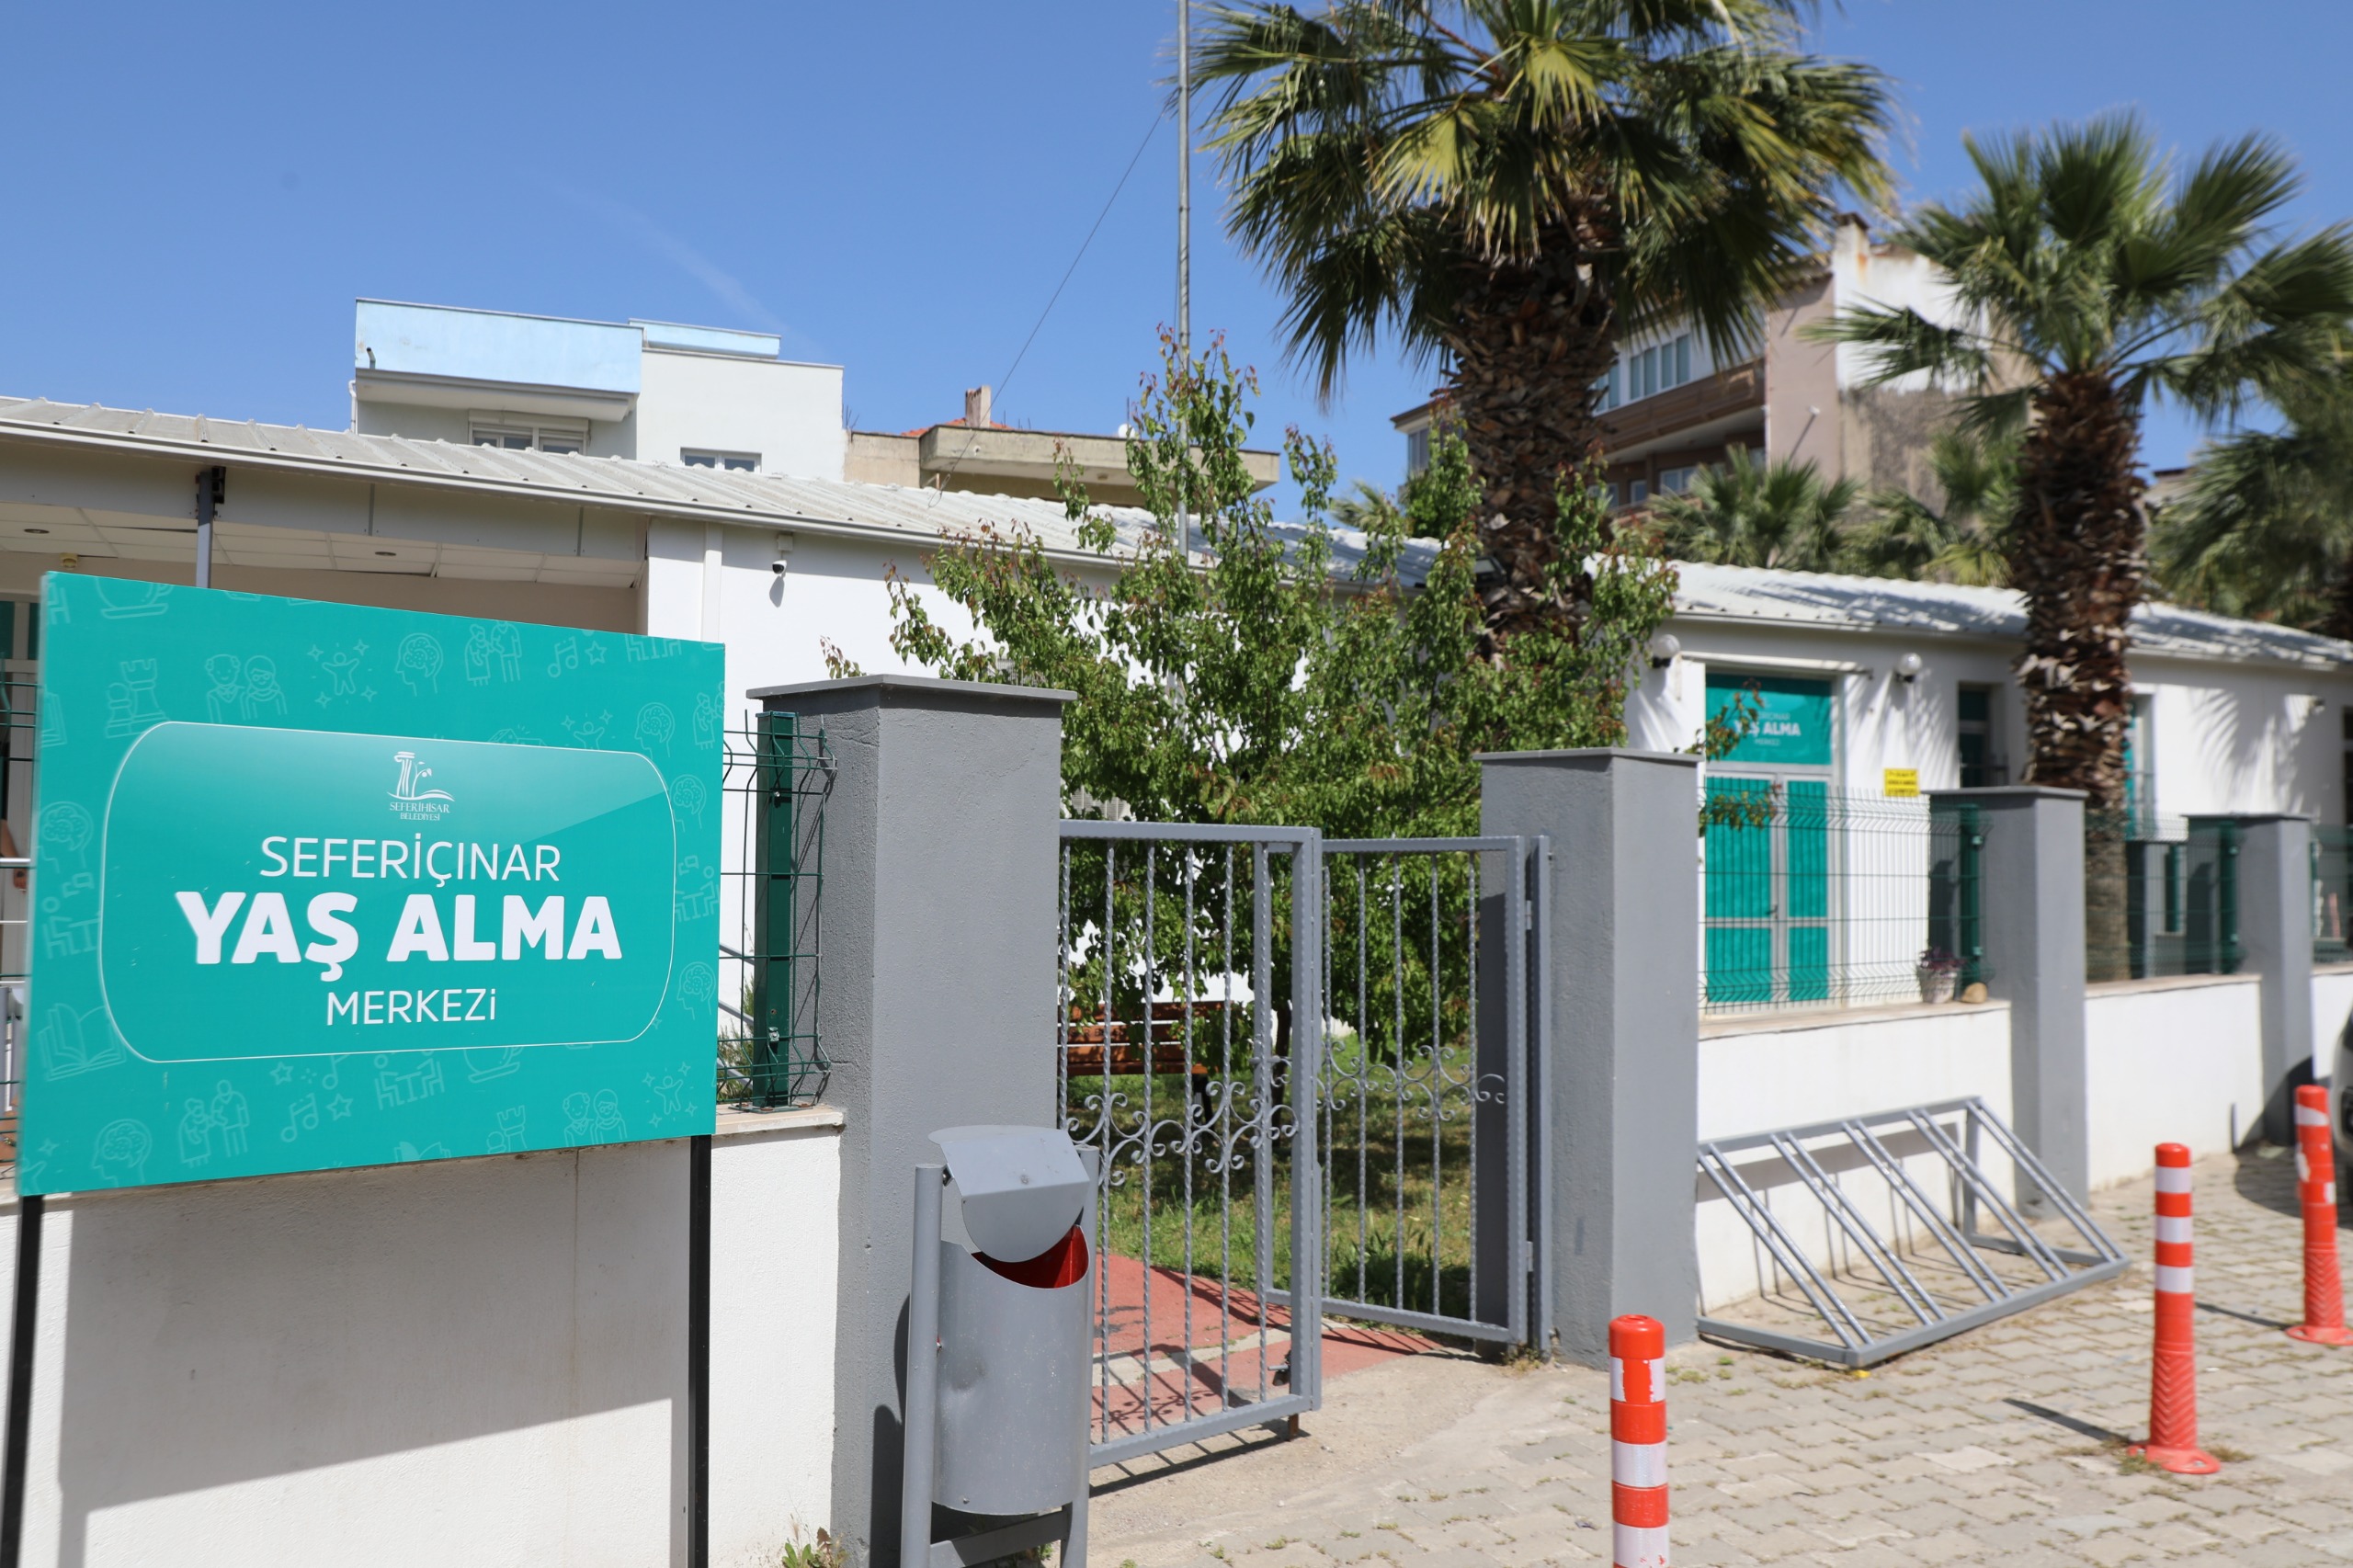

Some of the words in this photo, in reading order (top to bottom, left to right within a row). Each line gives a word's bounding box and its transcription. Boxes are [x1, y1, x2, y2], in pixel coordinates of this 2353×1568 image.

[1763, 721, 1802, 736] ALMA
[390, 801, 450, 813] SEFERİHİSAR
[400, 812, 440, 821] BELEDİYESİ
[260, 833, 561, 888] SEFERİÇINAR
[176, 891, 359, 983] YAŞ
[386, 893, 623, 962] ALMA
